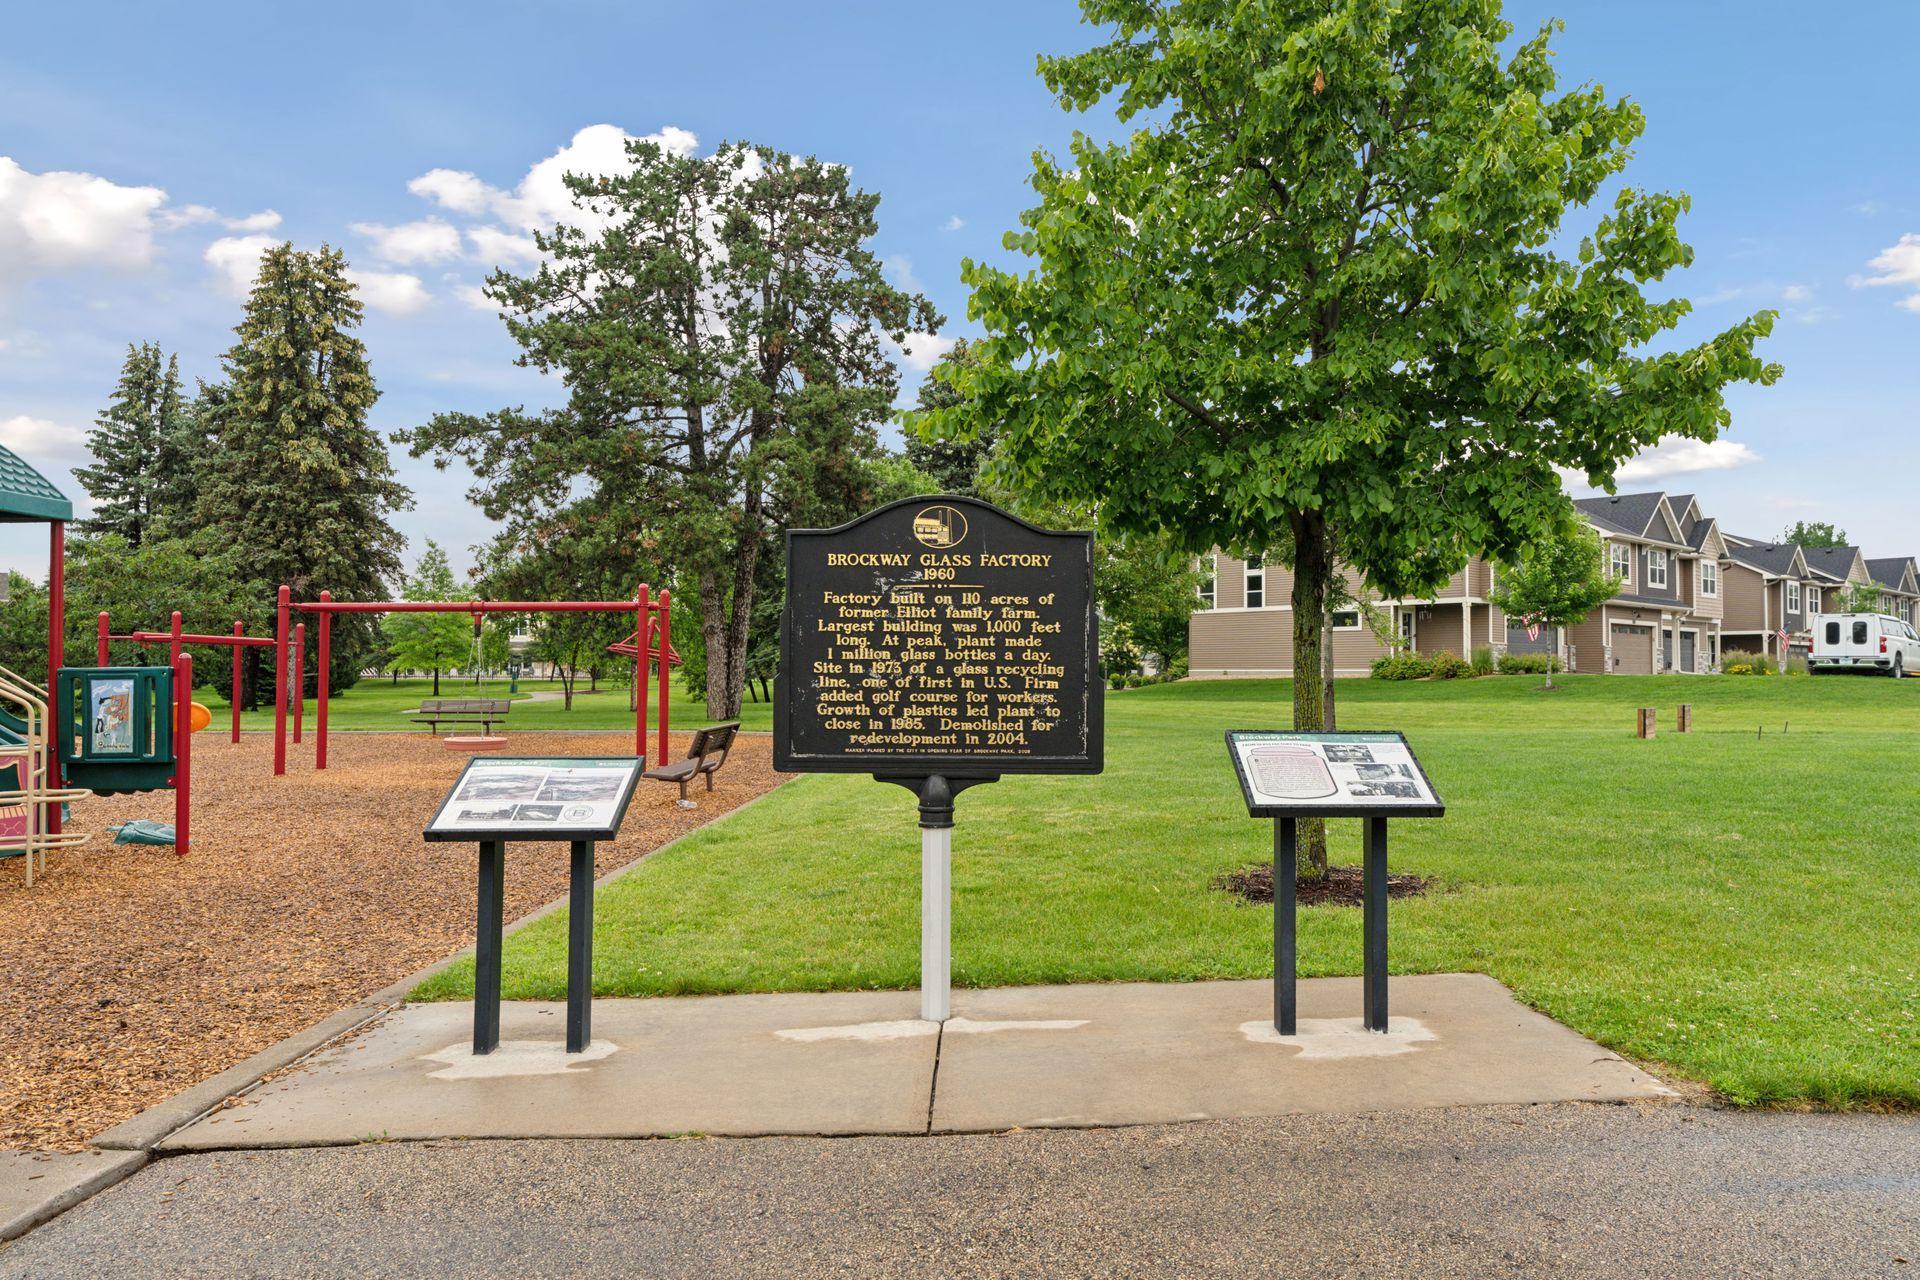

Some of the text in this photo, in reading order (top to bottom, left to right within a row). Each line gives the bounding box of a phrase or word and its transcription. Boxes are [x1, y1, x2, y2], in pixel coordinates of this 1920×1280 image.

[827, 553, 1052, 566] BROCKWAY GLASS FACTORY
[924, 567, 955, 580] 1960
[824, 591, 1055, 607] Factory built on 110 acres of
[839, 605, 1040, 621] former Elliot family farm.
[818, 619, 874, 635] Largest
[883, 619, 942, 635] building
[952, 623, 977, 632] was
[1031, 619, 1061, 632] feet
[836, 633, 871, 649] long.
[883, 633, 899, 646] At
[958, 633, 996, 649] plant
[1005, 633, 1042, 646] made
[827, 647, 1051, 663] 1 million glass bottles a day.
[813, 661, 1065, 677] Site in 1973 of a glass recycling
[819, 675, 1059, 690] line, one of first in U.S. Firm
[820, 689, 1058, 705] added golf course for workers.
[817, 703, 1060, 719] Growth of plastics led plant to
[824, 717, 1054, 730] close in 1985. Demolished for
[850, 731, 1028, 747] redevelopment in 2004.
